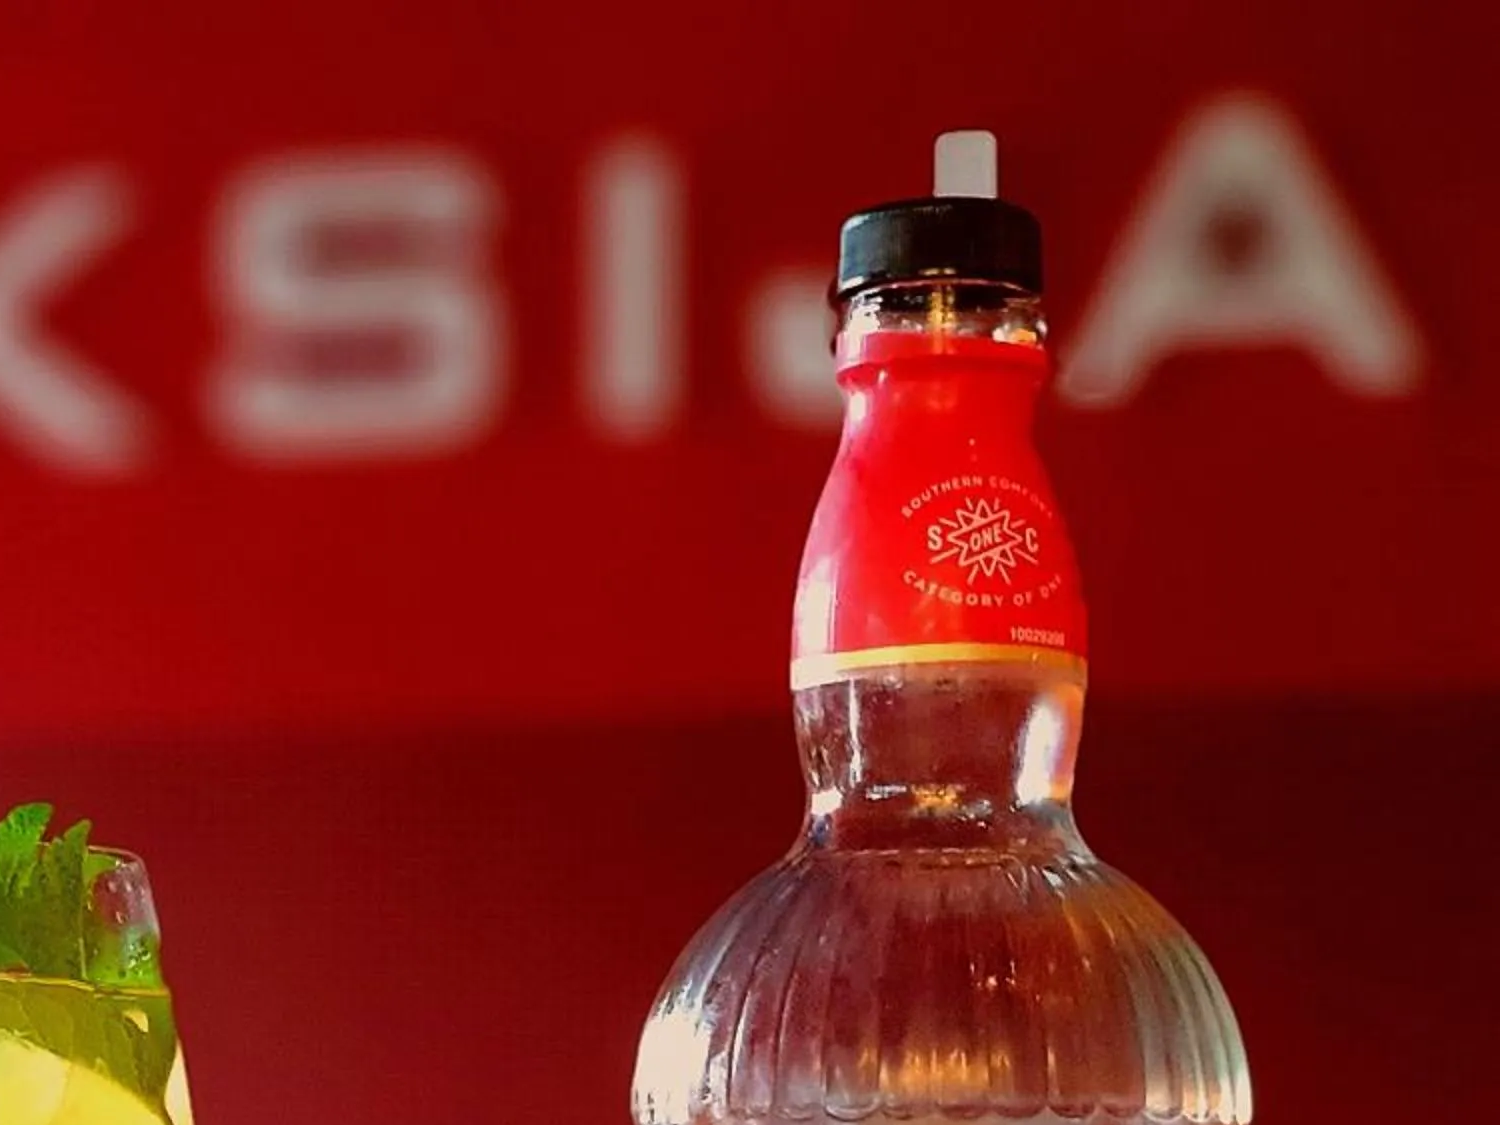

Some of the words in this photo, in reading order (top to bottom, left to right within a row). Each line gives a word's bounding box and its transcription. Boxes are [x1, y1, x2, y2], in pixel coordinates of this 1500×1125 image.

[901, 475, 982, 519] SOUTHERN
[927, 524, 942, 550] S
[969, 524, 1002, 551] ONE
[1025, 527, 1038, 552] C
[903, 570, 1004, 606] CATEGORY
[1013, 591, 1032, 606] OF
